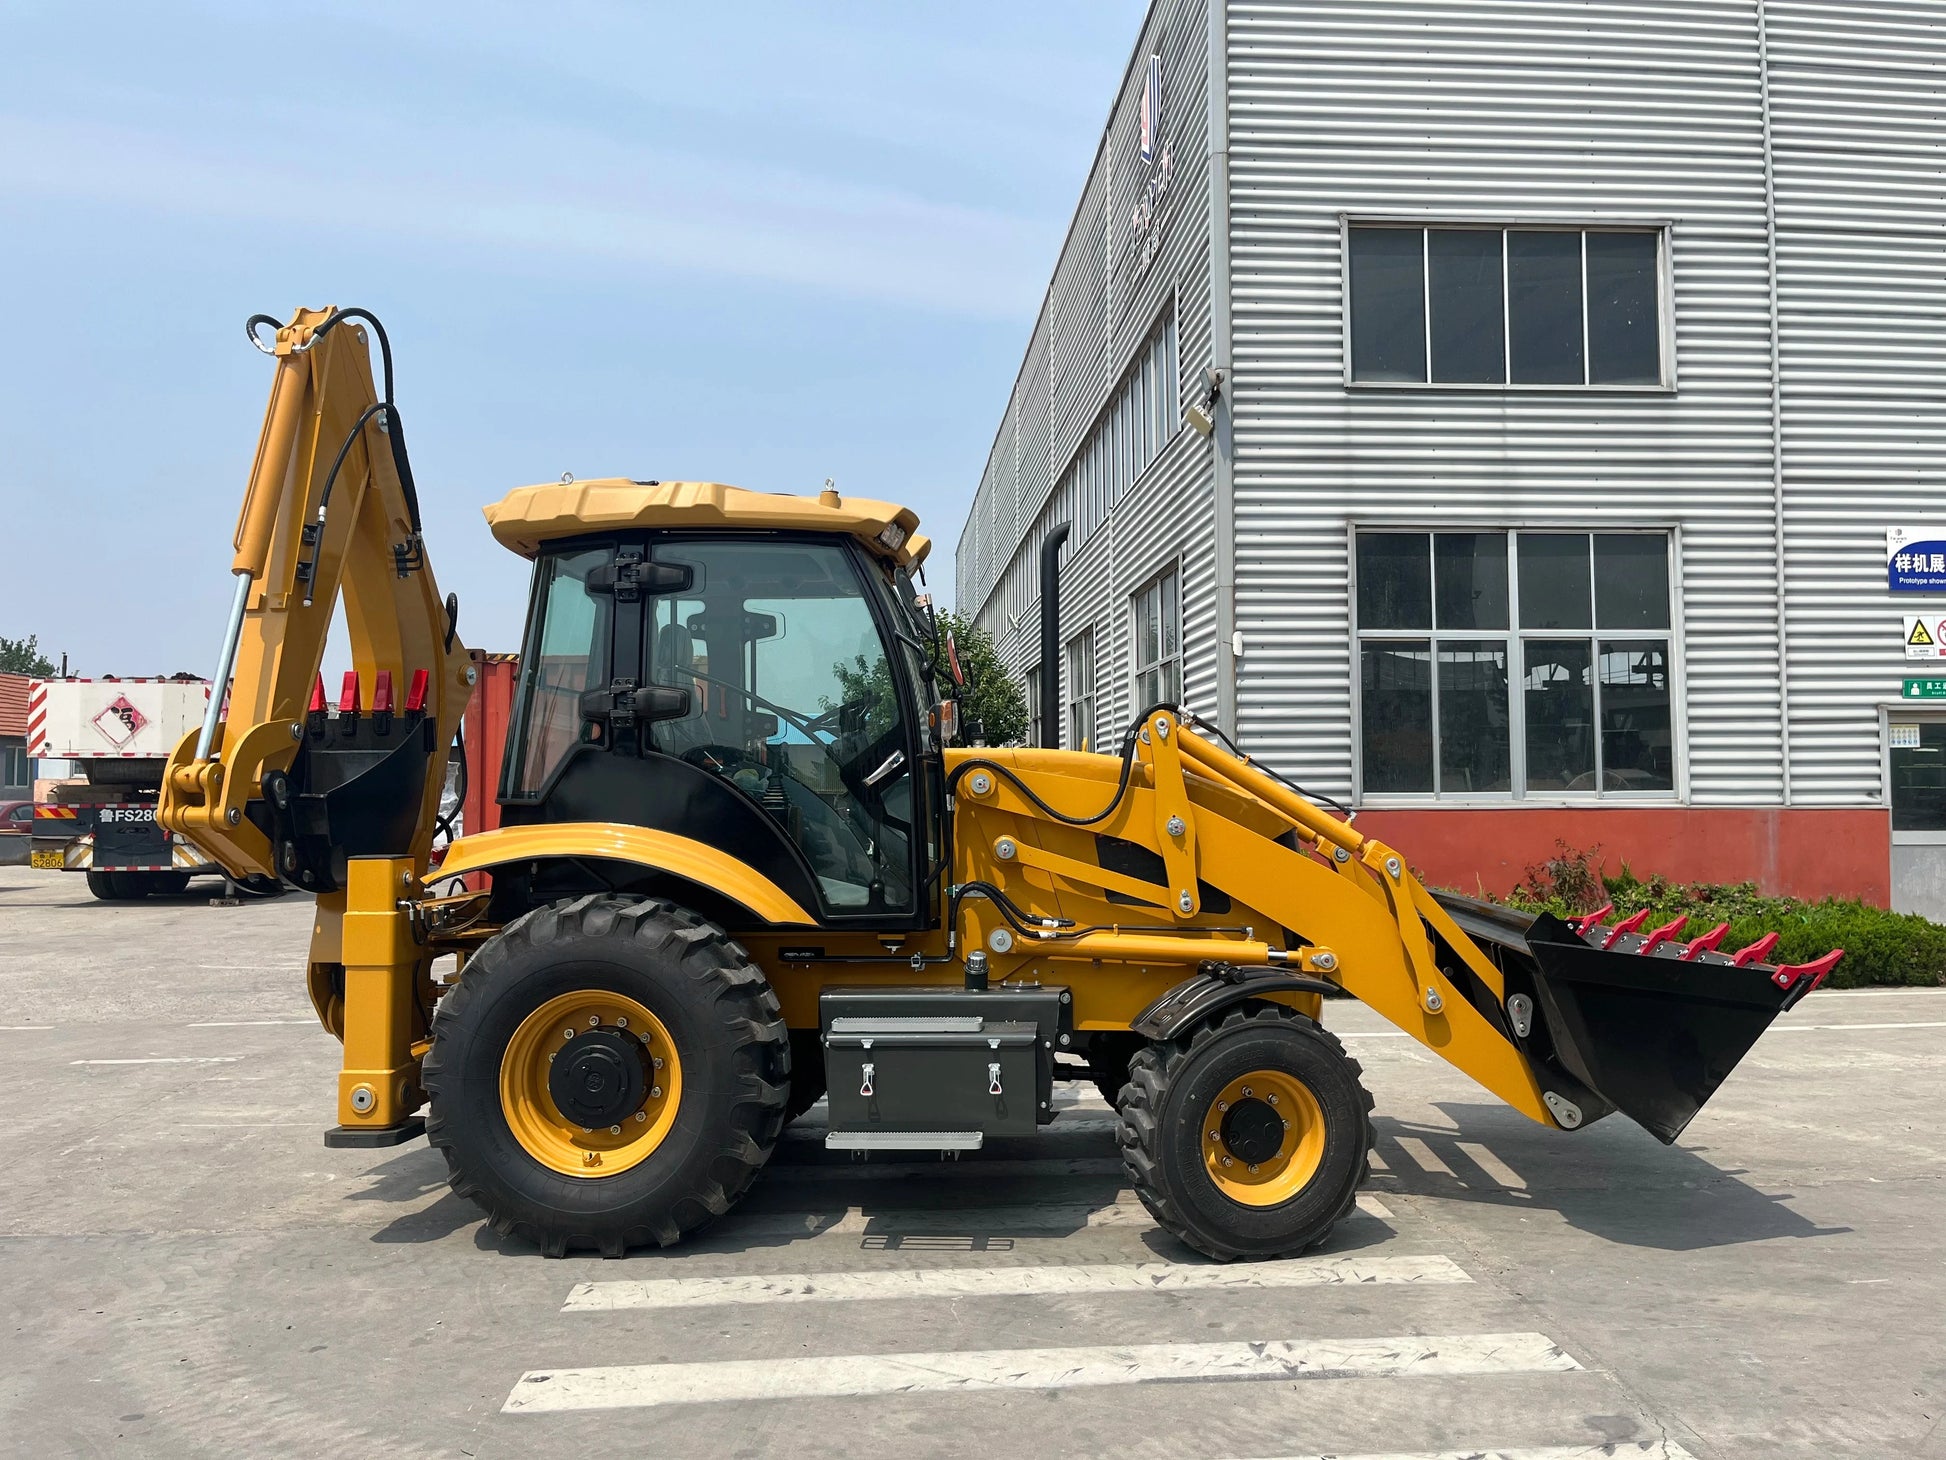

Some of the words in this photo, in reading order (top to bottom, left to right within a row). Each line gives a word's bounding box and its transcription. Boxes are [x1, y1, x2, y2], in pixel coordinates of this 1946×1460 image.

[1895, 553, 1946, 573] 样机展
[1899, 577, 1928, 585] Prototype
[33, 859, 63, 868] S2806
